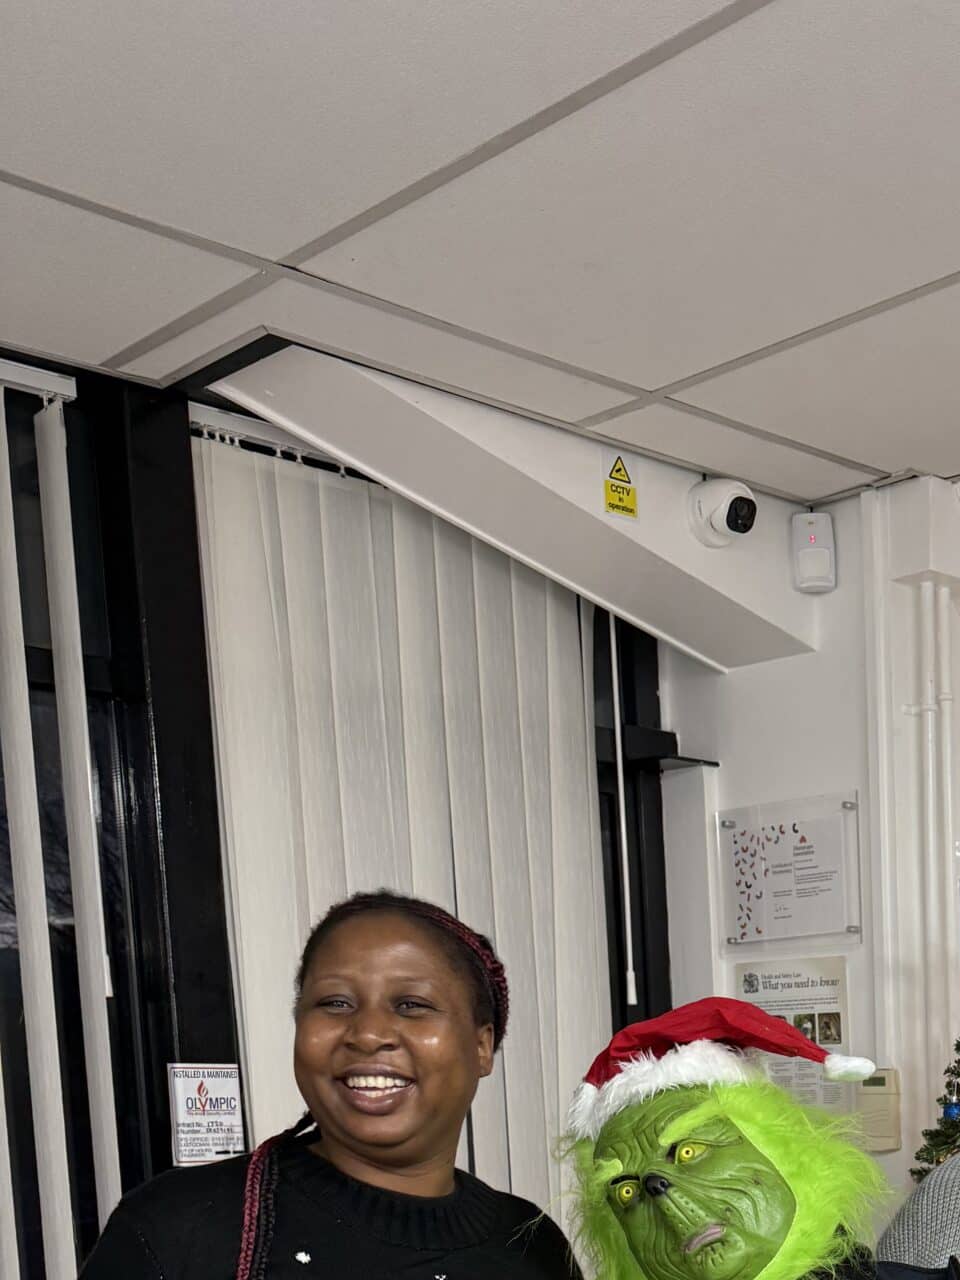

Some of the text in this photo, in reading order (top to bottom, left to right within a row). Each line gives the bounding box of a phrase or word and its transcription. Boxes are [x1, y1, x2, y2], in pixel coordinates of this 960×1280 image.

[611, 483, 631, 496] CCTV
[608, 502, 635, 514] operation
[761, 980, 779, 990] What
[780, 982, 793, 992] you
[794, 977, 810, 989] need
[811, 978, 818, 987] to
[173, 1070, 201, 1079] INSTALLED
[206, 1070, 238, 1079] MAINTAINED
[186, 1096, 237, 1113] OLYMPIC
